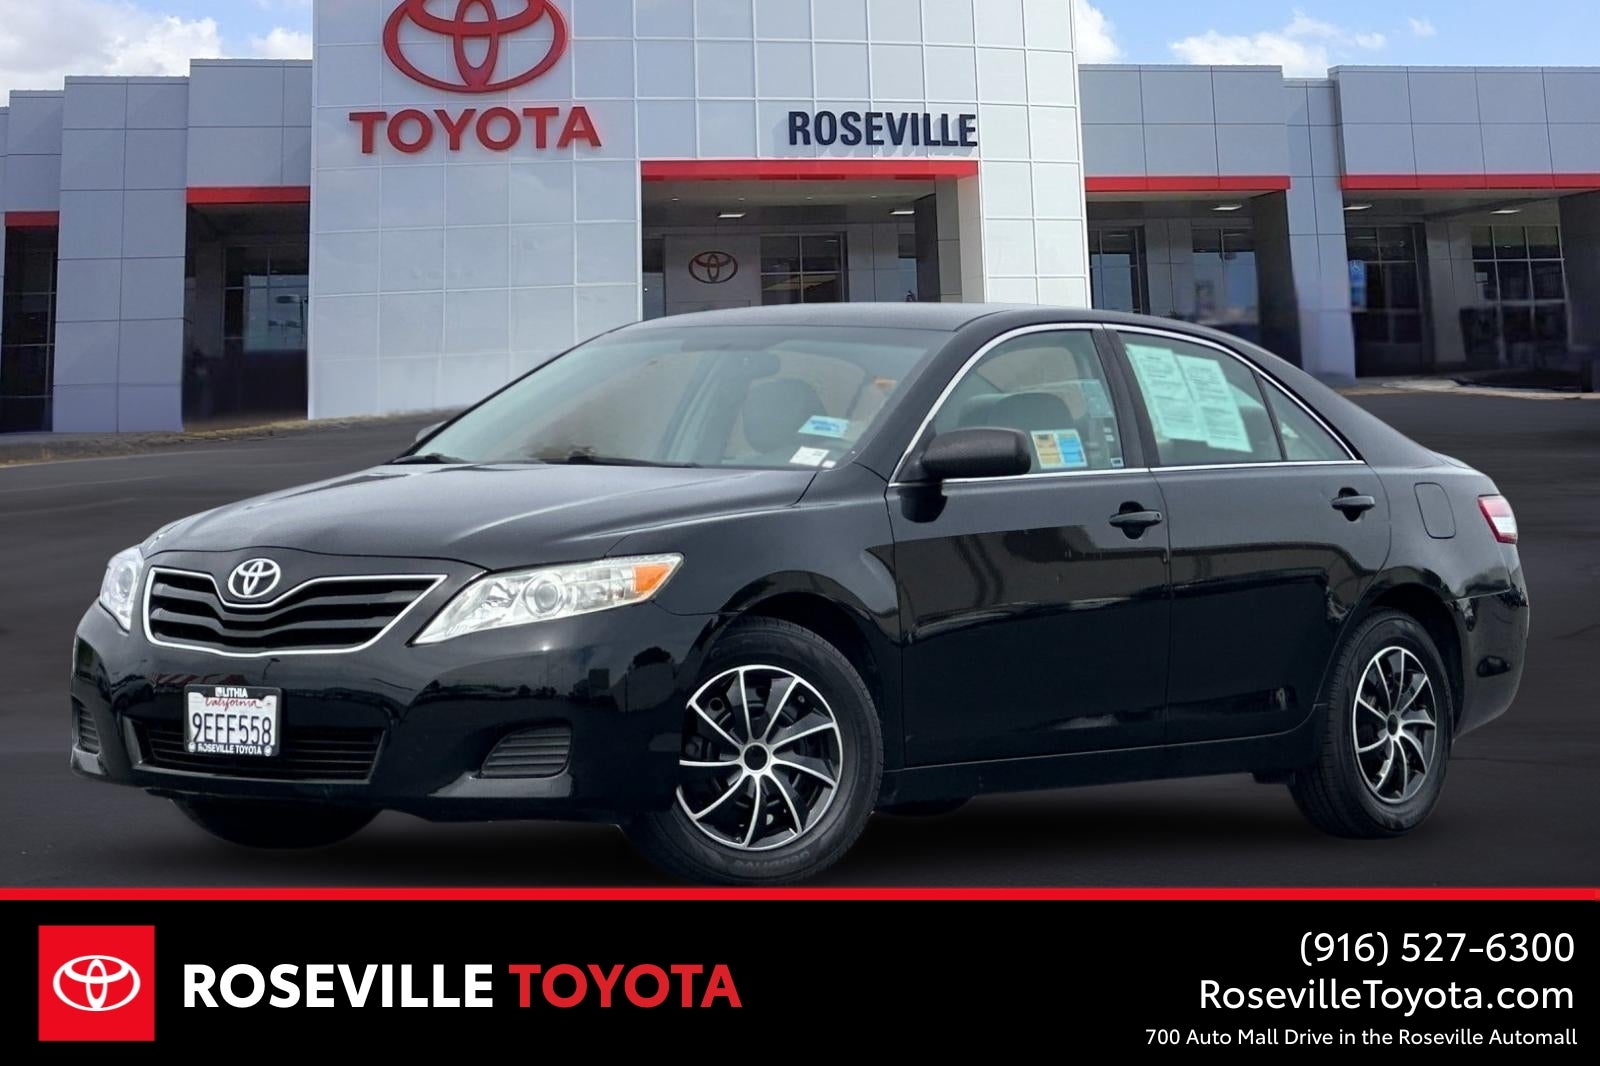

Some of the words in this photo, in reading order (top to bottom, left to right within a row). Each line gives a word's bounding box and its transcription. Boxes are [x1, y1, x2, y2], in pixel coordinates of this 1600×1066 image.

[349, 106, 602, 154] TOYOTA
[788, 110, 978, 147] ROSEVILLE
[205, 697, 257, 711] California
[223, 687, 248, 698] LITHIA
[192, 712, 272, 745] 9EFF558
[197, 743, 234, 754] ROSEVILLE
[235, 745, 262, 755] TOYOTA
